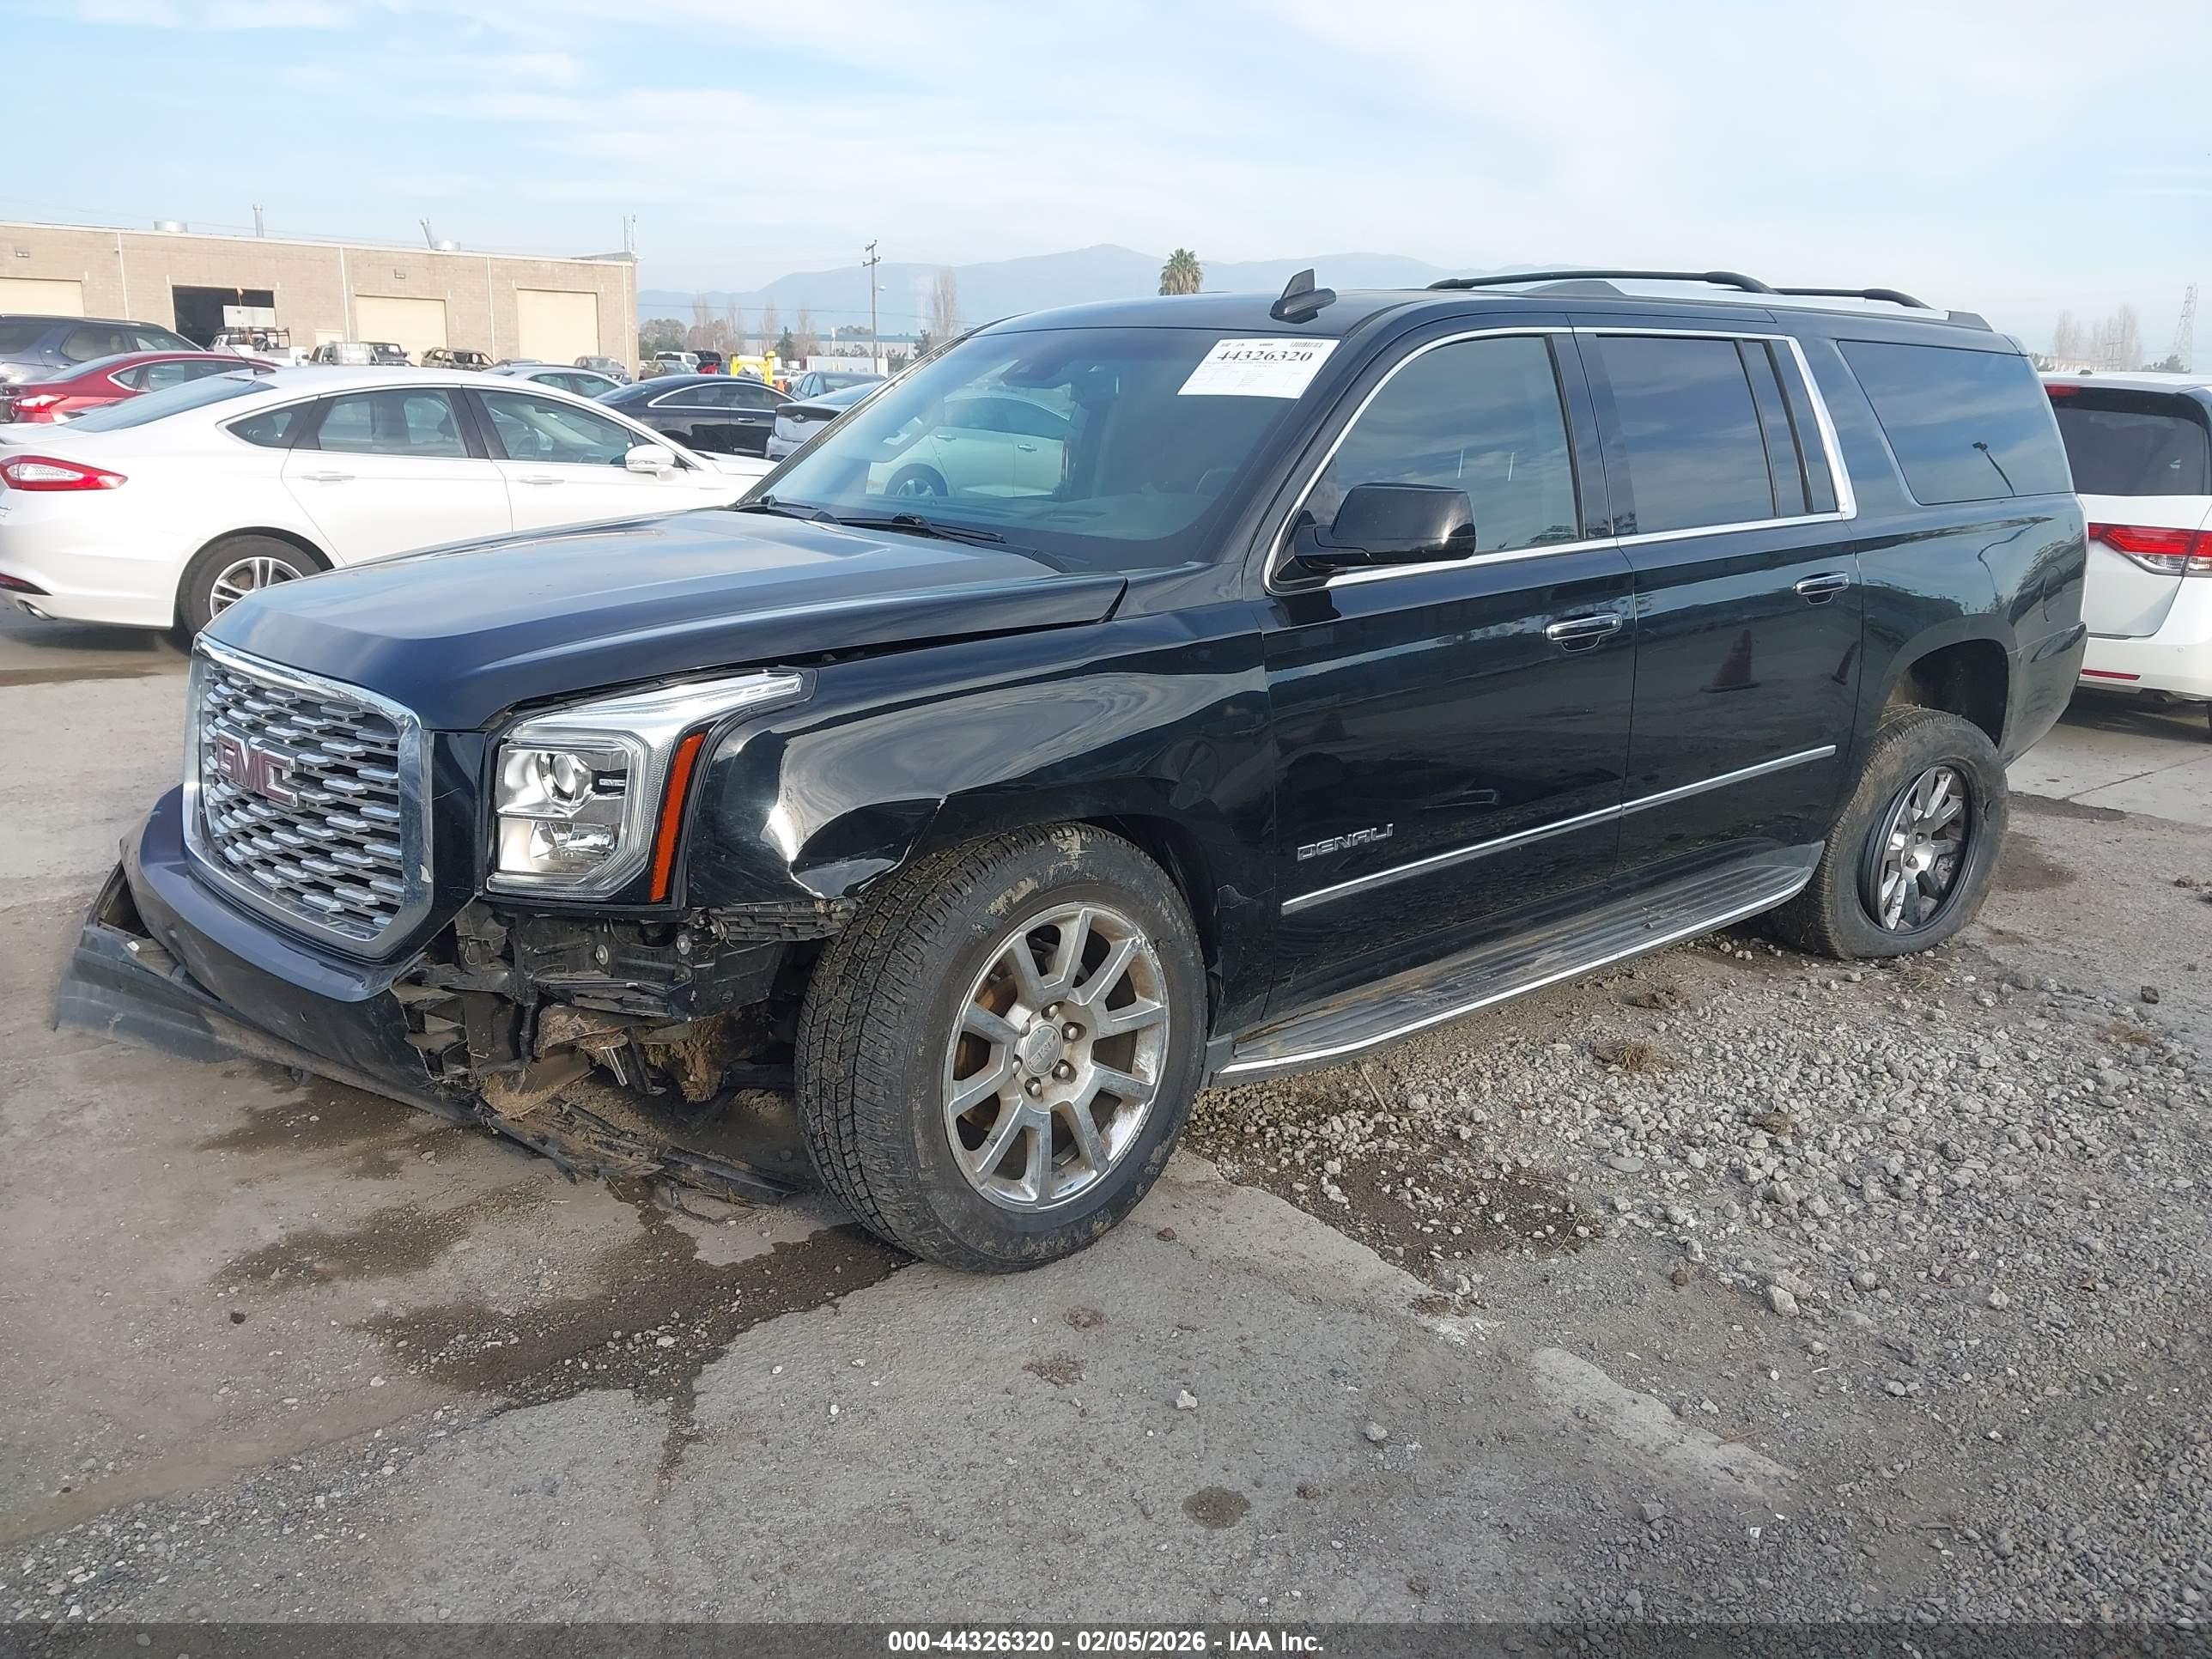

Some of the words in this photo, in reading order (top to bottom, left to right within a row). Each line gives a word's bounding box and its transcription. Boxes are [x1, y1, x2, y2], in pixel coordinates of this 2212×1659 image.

[1217, 350, 1313, 362] 44326320
[216, 730, 297, 806] GMC
[1297, 823, 1394, 861] DENALI
